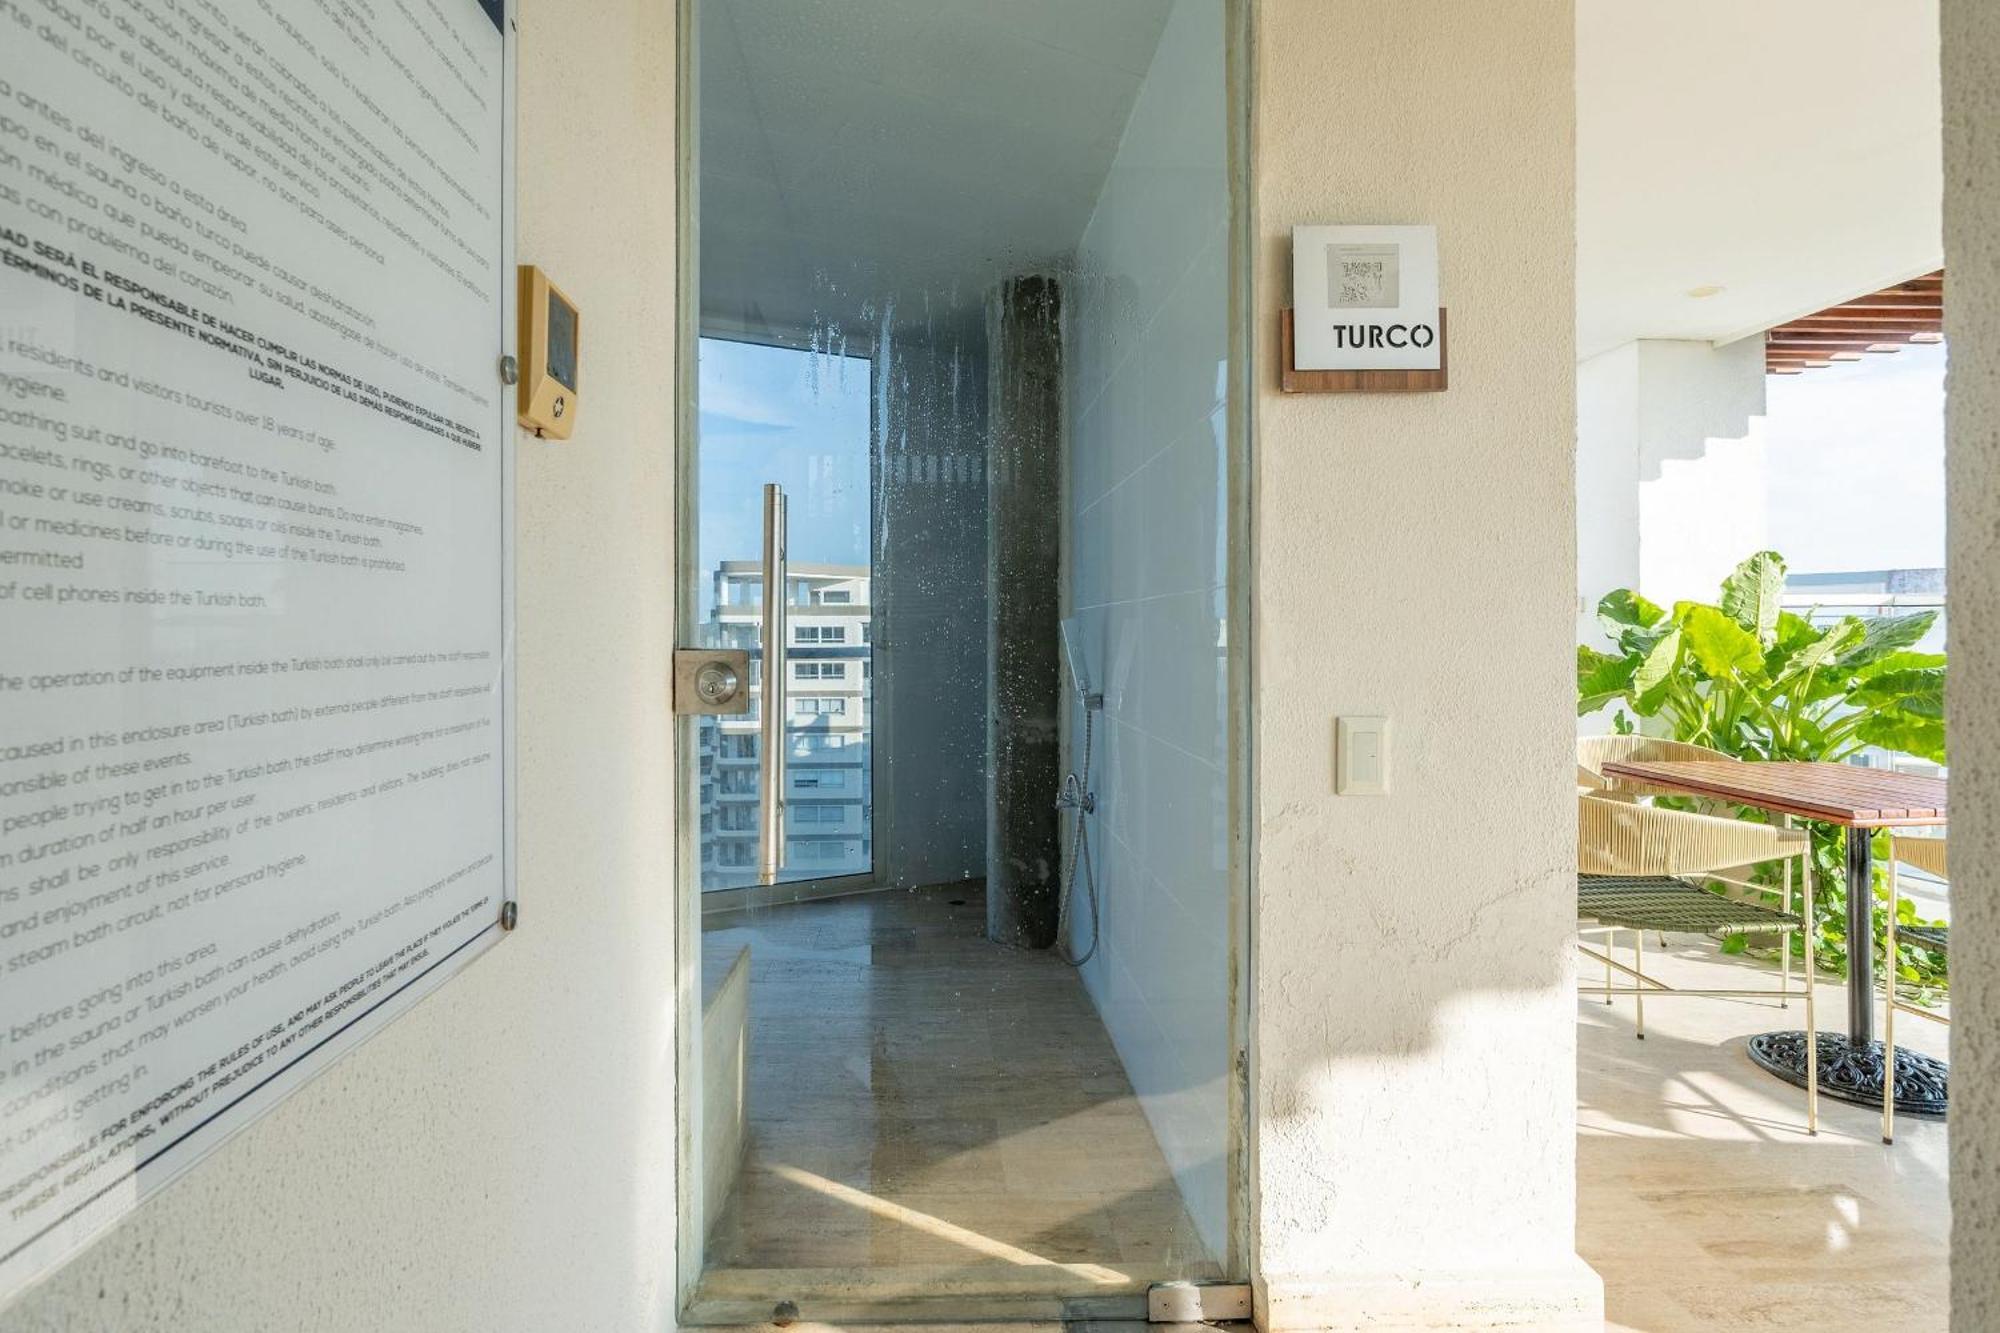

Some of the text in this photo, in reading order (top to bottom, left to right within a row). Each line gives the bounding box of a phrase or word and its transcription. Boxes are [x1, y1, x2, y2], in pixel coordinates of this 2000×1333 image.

[37, 20, 67, 54] del
[16, 89, 72, 133] antes
[34, 133, 59, 158] en
[63, 149, 81, 170] el
[28, 163, 98, 211] médica
[26, 196, 63, 225] con
[0, 225, 28, 250] AD
[33, 239, 76, 270] SERÁ
[80, 259, 99, 280] EL
[103, 269, 198, 322] RESPONSABLE
[201, 311, 216, 329] DE
[219, 319, 254, 345] HACER
[257, 335, 297, 363] CUMPLIR
[299, 354, 316, 371] LAS
[317, 362, 351, 386] NORMAS
[83, 281, 103, 302] DE
[107, 291, 126, 311] LA
[129, 300, 195, 338] PRESENTE
[198, 328, 264, 367] NORMATIVA,
[266, 356, 282, 373] SIN
[284, 363, 329, 391] PERJUICIO
[330, 382, 341, 396] DE
[1333, 324, 1433, 348] TURCO
[8, 338, 94, 378] residents
[97, 366, 129, 388] and
[248, 366, 284, 390] LUGAR.
[71, 423, 101, 444] suit
[105, 432, 136, 451] and
[118, 465, 134, 481] or
[49, 485, 66, 502] or
[72, 490, 103, 507] use
[8, 514, 28, 530] or
[34, 516, 121, 541] medicines
[0, 579, 16, 600] of
[21, 581, 53, 601] cell
[57, 583, 120, 605] phones
[29, 668, 114, 692] operation
[118, 664, 133, 683] of
[69, 734, 84, 752] in
[89, 729, 118, 749] this
[72, 763, 89, 785] of
[95, 760, 139, 780] these
[3, 803, 68, 837] people
[73, 793, 121, 818] trying
[18, 832, 94, 864] duration
[98, 821, 114, 843] of
[29, 866, 70, 896] shall
[78, 861, 100, 881] be
[108, 849, 139, 872] only
[1, 909, 39, 939] and
[43, 882, 132, 925] enjoyment
[8, 937, 69, 972] steam
[73, 918, 112, 948] bath
[10, 1004, 73, 1044] before
[78, 982, 122, 1019] going
[12, 1057, 30, 1078] in
[34, 1040, 65, 1068] the
[69, 1014, 121, 1051] sauna
[100, 1115, 127, 1142] FOR
[130, 1075, 194, 1125] ENFORCING
[197, 1061, 217, 1083] THE
[219, 1041, 249, 1070] RULES
[251, 1032, 264, 1050] OF
[266, 1021, 285, 1041] USE,
[287, 1009, 304, 1028] AND
[305, 998, 322, 1016] MAY
[323, 988, 337, 1006] ASK
[102, 1036, 133, 1066] that
[159, 1085, 208, 1127] WITHOUT
[212, 1051, 263, 1094] PREJUDICE
[266, 1042, 278, 1059] TO
[279, 1030, 296, 1051] ANY
[298, 1013, 323, 1038] OTHER
[74, 1072, 129, 1121] getting
